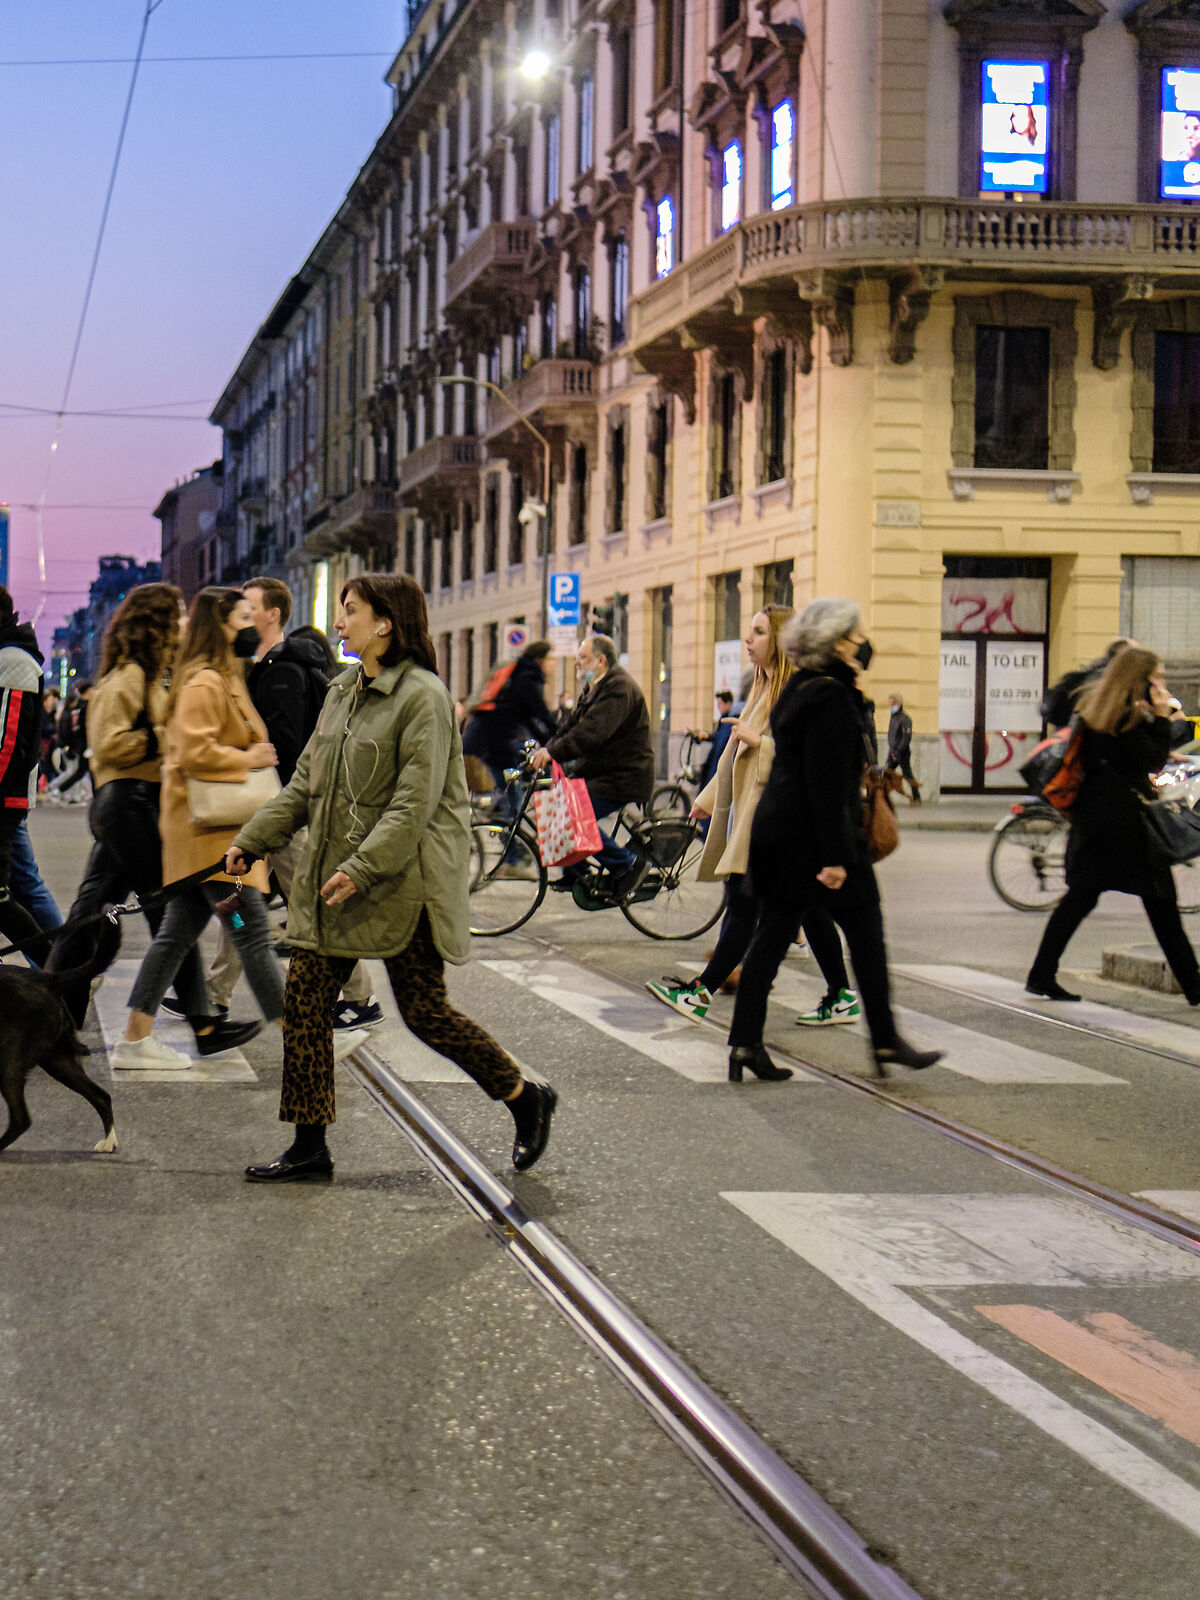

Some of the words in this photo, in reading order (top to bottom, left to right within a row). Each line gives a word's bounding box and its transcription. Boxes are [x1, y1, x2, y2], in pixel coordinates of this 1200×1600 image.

[555, 576, 574, 603] P
[992, 654, 1010, 668] TO
[1013, 654, 1038, 668] LET
